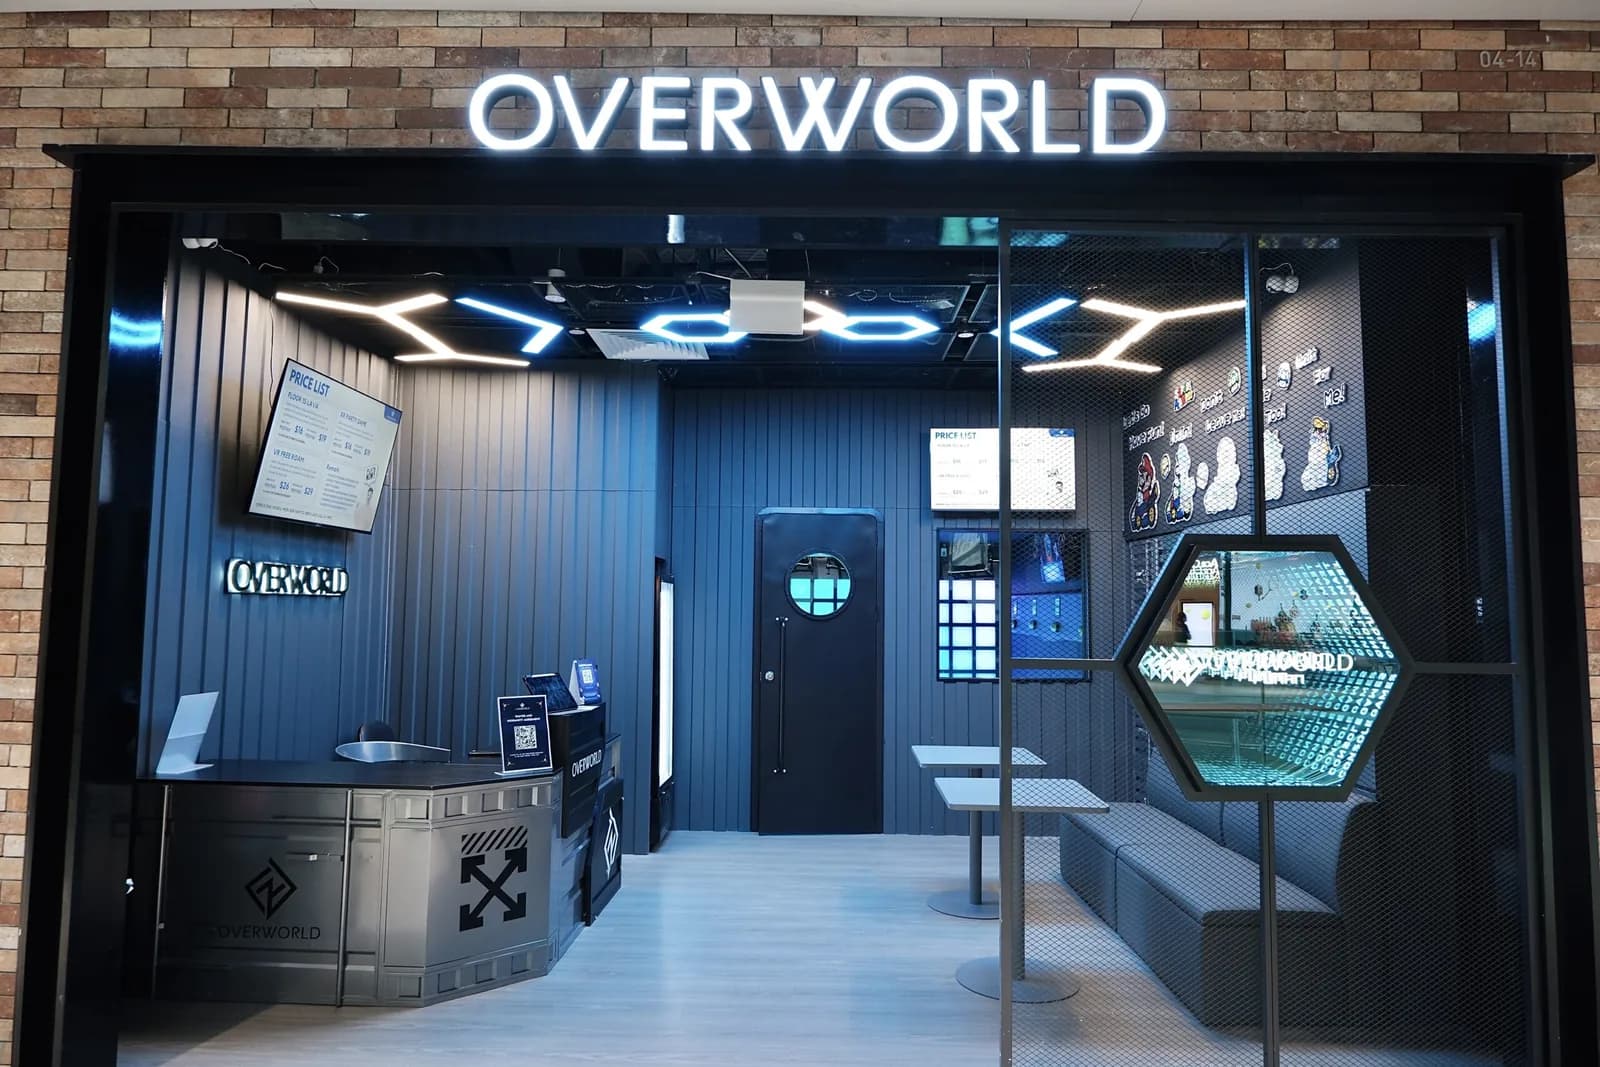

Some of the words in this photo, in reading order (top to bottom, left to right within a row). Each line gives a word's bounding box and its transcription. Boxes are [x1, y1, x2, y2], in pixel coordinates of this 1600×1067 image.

[1480, 50, 1537, 68] 04-14
[469, 73, 1168, 155] OVERWORLD
[289, 368, 313, 391] PRICE
[313, 379, 331, 398] LIST
[1324, 383, 1346, 409] Me!
[935, 431, 958, 440] PRICE
[959, 431, 977, 440] LIST
[225, 558, 350, 597] OVERWORLD
[1338, 719, 1374, 778] CONSOLE
[1370, 673, 1398, 718] GAMES
[571, 749, 602, 778] OVERWORLD
[216, 924, 321, 940] OVERWORLD
